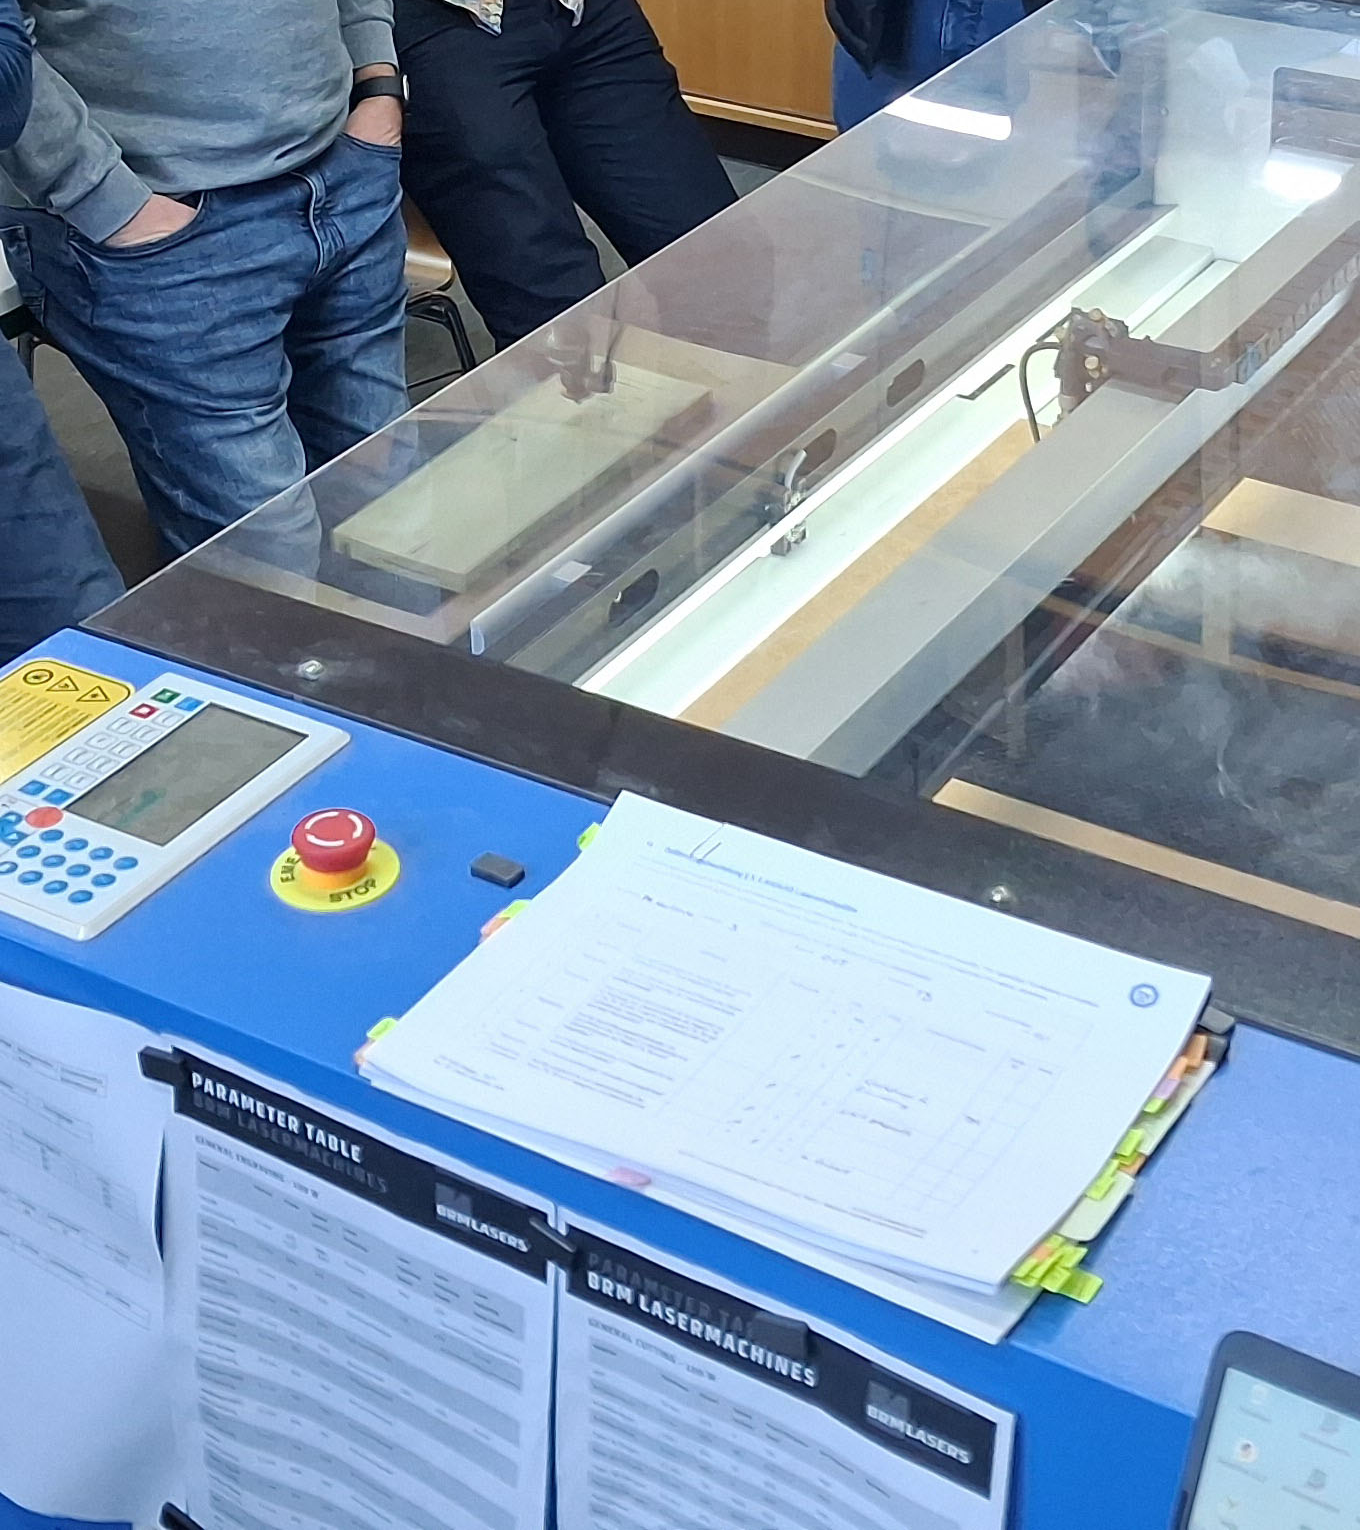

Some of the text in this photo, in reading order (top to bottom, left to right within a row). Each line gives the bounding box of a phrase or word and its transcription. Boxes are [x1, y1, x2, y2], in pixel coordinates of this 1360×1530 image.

[328, 877, 377, 903] STOP
[191, 1071, 362, 1164] PARAMETER TABLE
[587, 1269, 817, 1388] BRM LASERMACHINES
